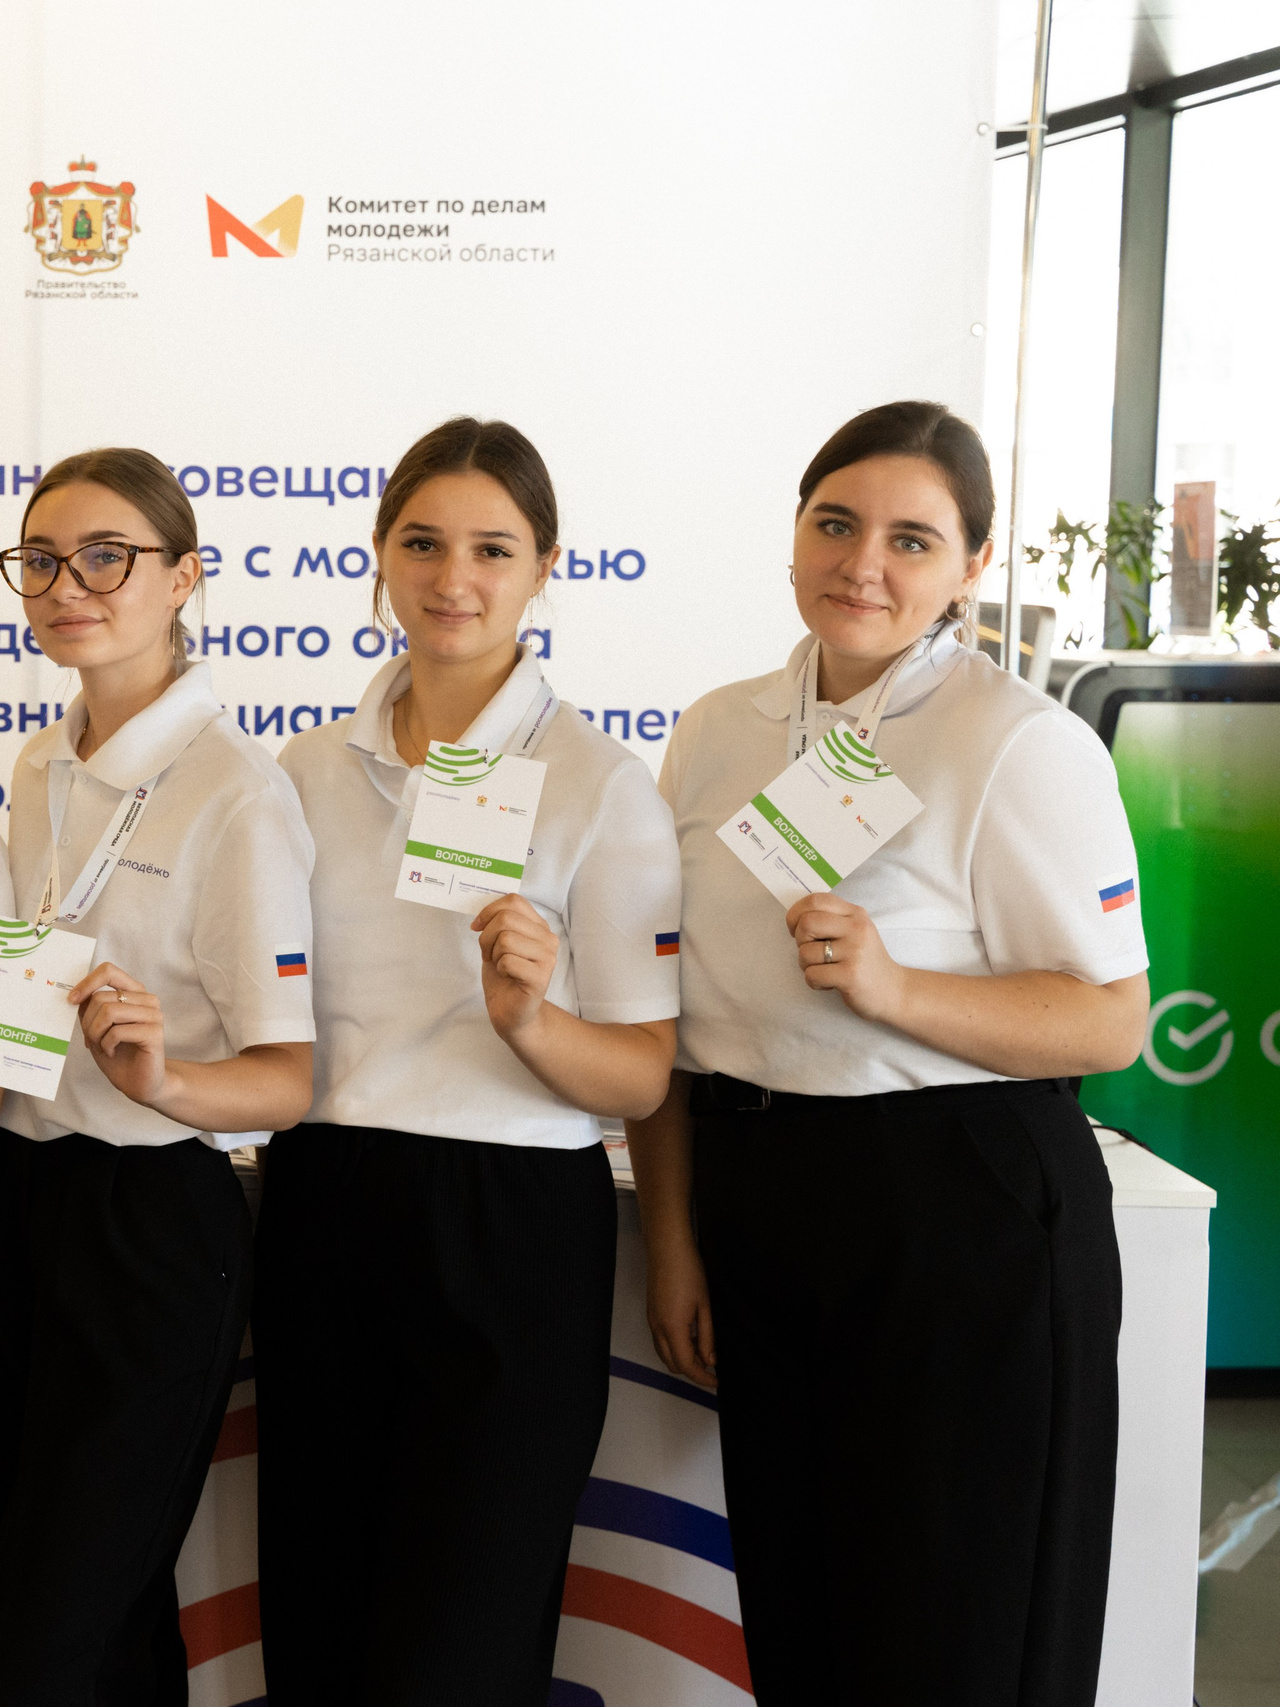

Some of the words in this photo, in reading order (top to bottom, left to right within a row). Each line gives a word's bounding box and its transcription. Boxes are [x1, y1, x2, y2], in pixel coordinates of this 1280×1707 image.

[327, 196, 429, 214] Комитет
[436, 199, 465, 214] по
[471, 199, 547, 216] делам
[327, 223, 450, 240] молодежи
[327, 243, 452, 262] Рязанской
[459, 243, 556, 262] области
[772, 815, 819, 864] ВОЛОНТЁР
[117, 858, 170, 879] олодёжь
[434, 848, 493, 870] ВОЛОНТЁР
